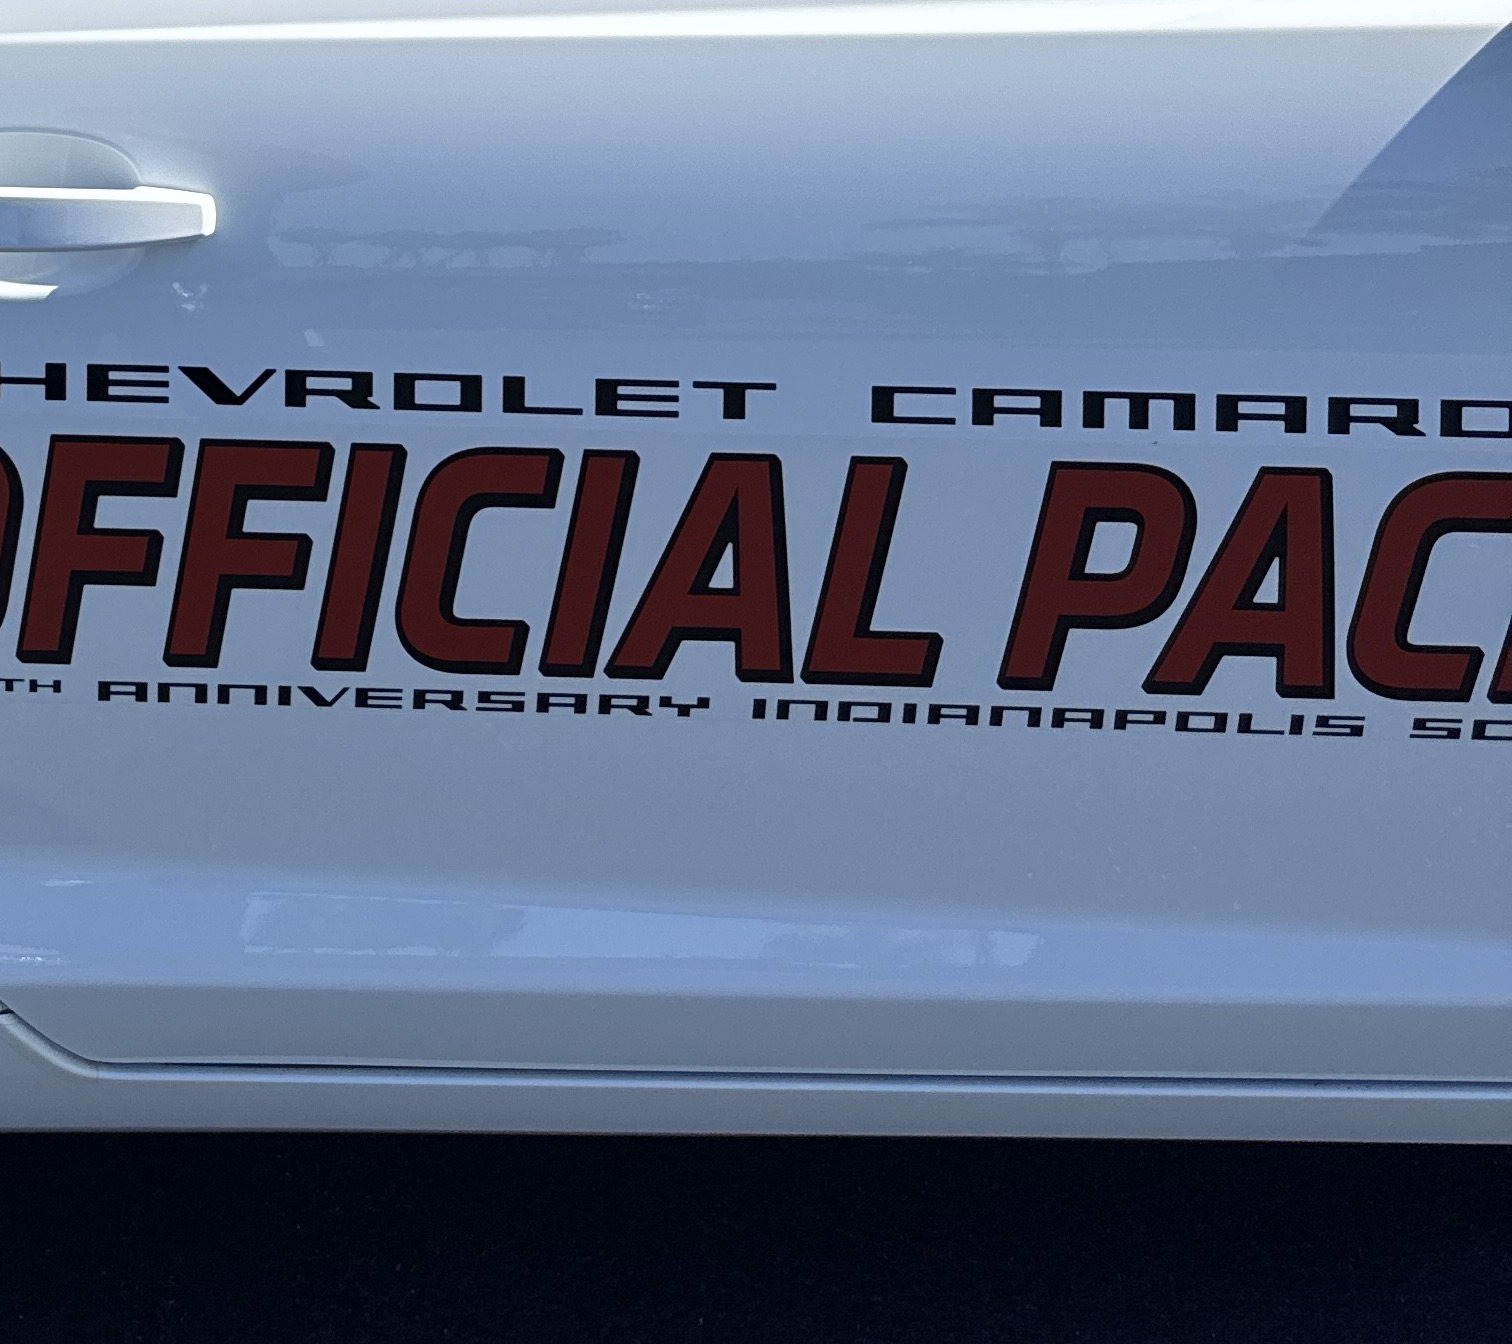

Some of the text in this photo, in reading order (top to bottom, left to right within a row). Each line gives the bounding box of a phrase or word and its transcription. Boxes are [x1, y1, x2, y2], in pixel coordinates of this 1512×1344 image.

[870, 385, 1512, 439] CAMARO
[996, 459, 1512, 705] PAC
[97, 680, 710, 717] ANNIVERSARY
[751, 697, 1366, 738] INDIANAPOLIS
